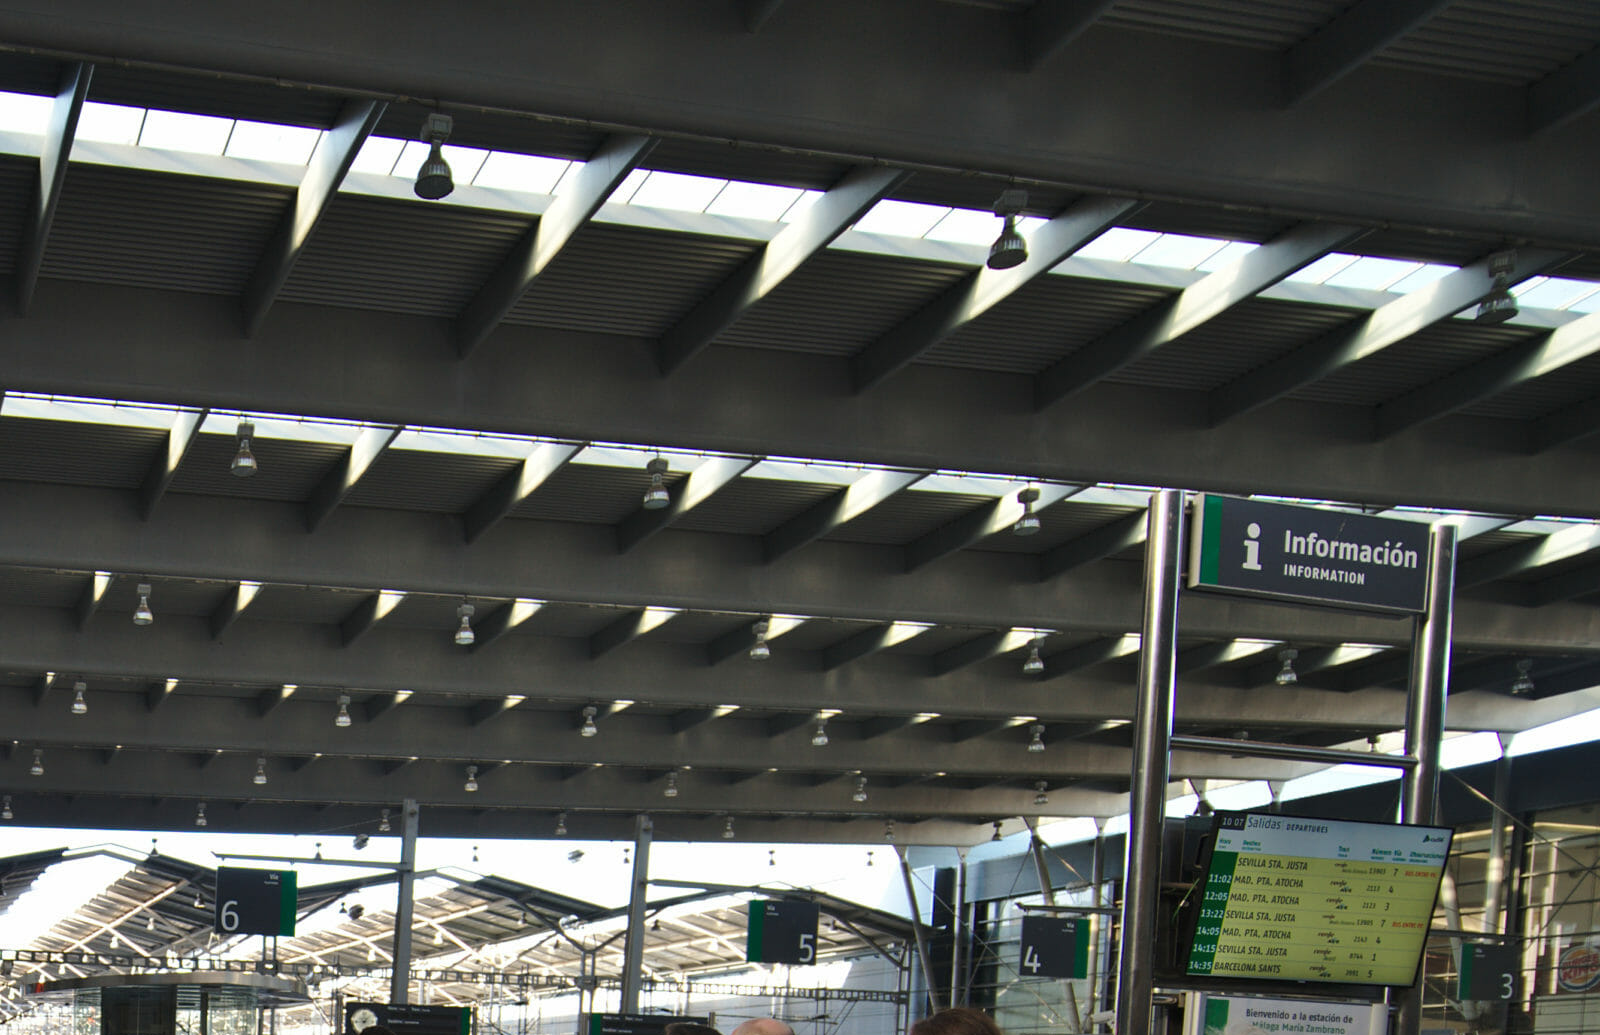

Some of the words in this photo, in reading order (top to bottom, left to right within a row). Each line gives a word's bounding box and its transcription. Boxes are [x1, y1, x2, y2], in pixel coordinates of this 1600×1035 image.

[1284, 529, 1418, 569] Información
[1283, 563, 1366, 585] INFORMATION
[1247, 816, 1281, 830] Salidas
[1286, 823, 1329, 834] DEPARTURES
[1237, 857, 1266, 868] SEVILLA
[1268, 859, 1284, 869] STA.
[1286, 861, 1308, 871] JUSTA
[1208, 874, 1232, 884] 11:02
[1393, 868, 1399, 877] 7
[1234, 875, 1254, 885] MAD.
[1256, 877, 1273, 886] PTA.
[1275, 878, 1304, 888] ATOCHA
[1204, 892, 1228, 901] 12:05
[1230, 893, 1250, 902] MAD.
[1252, 894, 1269, 904] PTA.
[1271, 896, 1300, 905] ATOCHA
[1384, 902, 1390, 911] 3
[221, 899, 240, 931] 6
[1200, 909, 1224, 918] 13:22
[1225, 910, 1254, 920] SEVILLA
[1255, 911, 1272, 921] STA.
[1273, 913, 1296, 923] JUSTA
[1381, 919, 1386, 927] 7
[1196, 926, 1220, 936] 14:05
[1222, 927, 1242, 937] MAD.
[1244, 928, 1261, 938] PTA.
[1263, 930, 1292, 939] ATOCHA
[799, 933, 814, 963] 5
[1192, 944, 1217, 953] 14:15
[1217, 944, 1246, 954] SEVILLA
[1247, 946, 1264, 955] STA.
[1265, 948, 1288, 957] JUSTA
[1023, 945, 1041, 974] 4
[1188, 961, 1213, 970] 14:35
[1214, 961, 1256, 972] BARCELONA
[1258, 963, 1281, 974] SANTS
[1367, 969, 1374, 978] 5
[1500, 973, 1513, 999] 3
[1246, 1008, 1290, 1020] Bienvenido
[1291, 1012, 1297, 1020] a
[1300, 1011, 1307, 1021] la
[1308, 1012, 1341, 1024] estación
[1343, 1015, 1353, 1024] de
[1282, 1022, 1304, 1033] María
[1306, 1024, 1345, 1035] Zambrano
